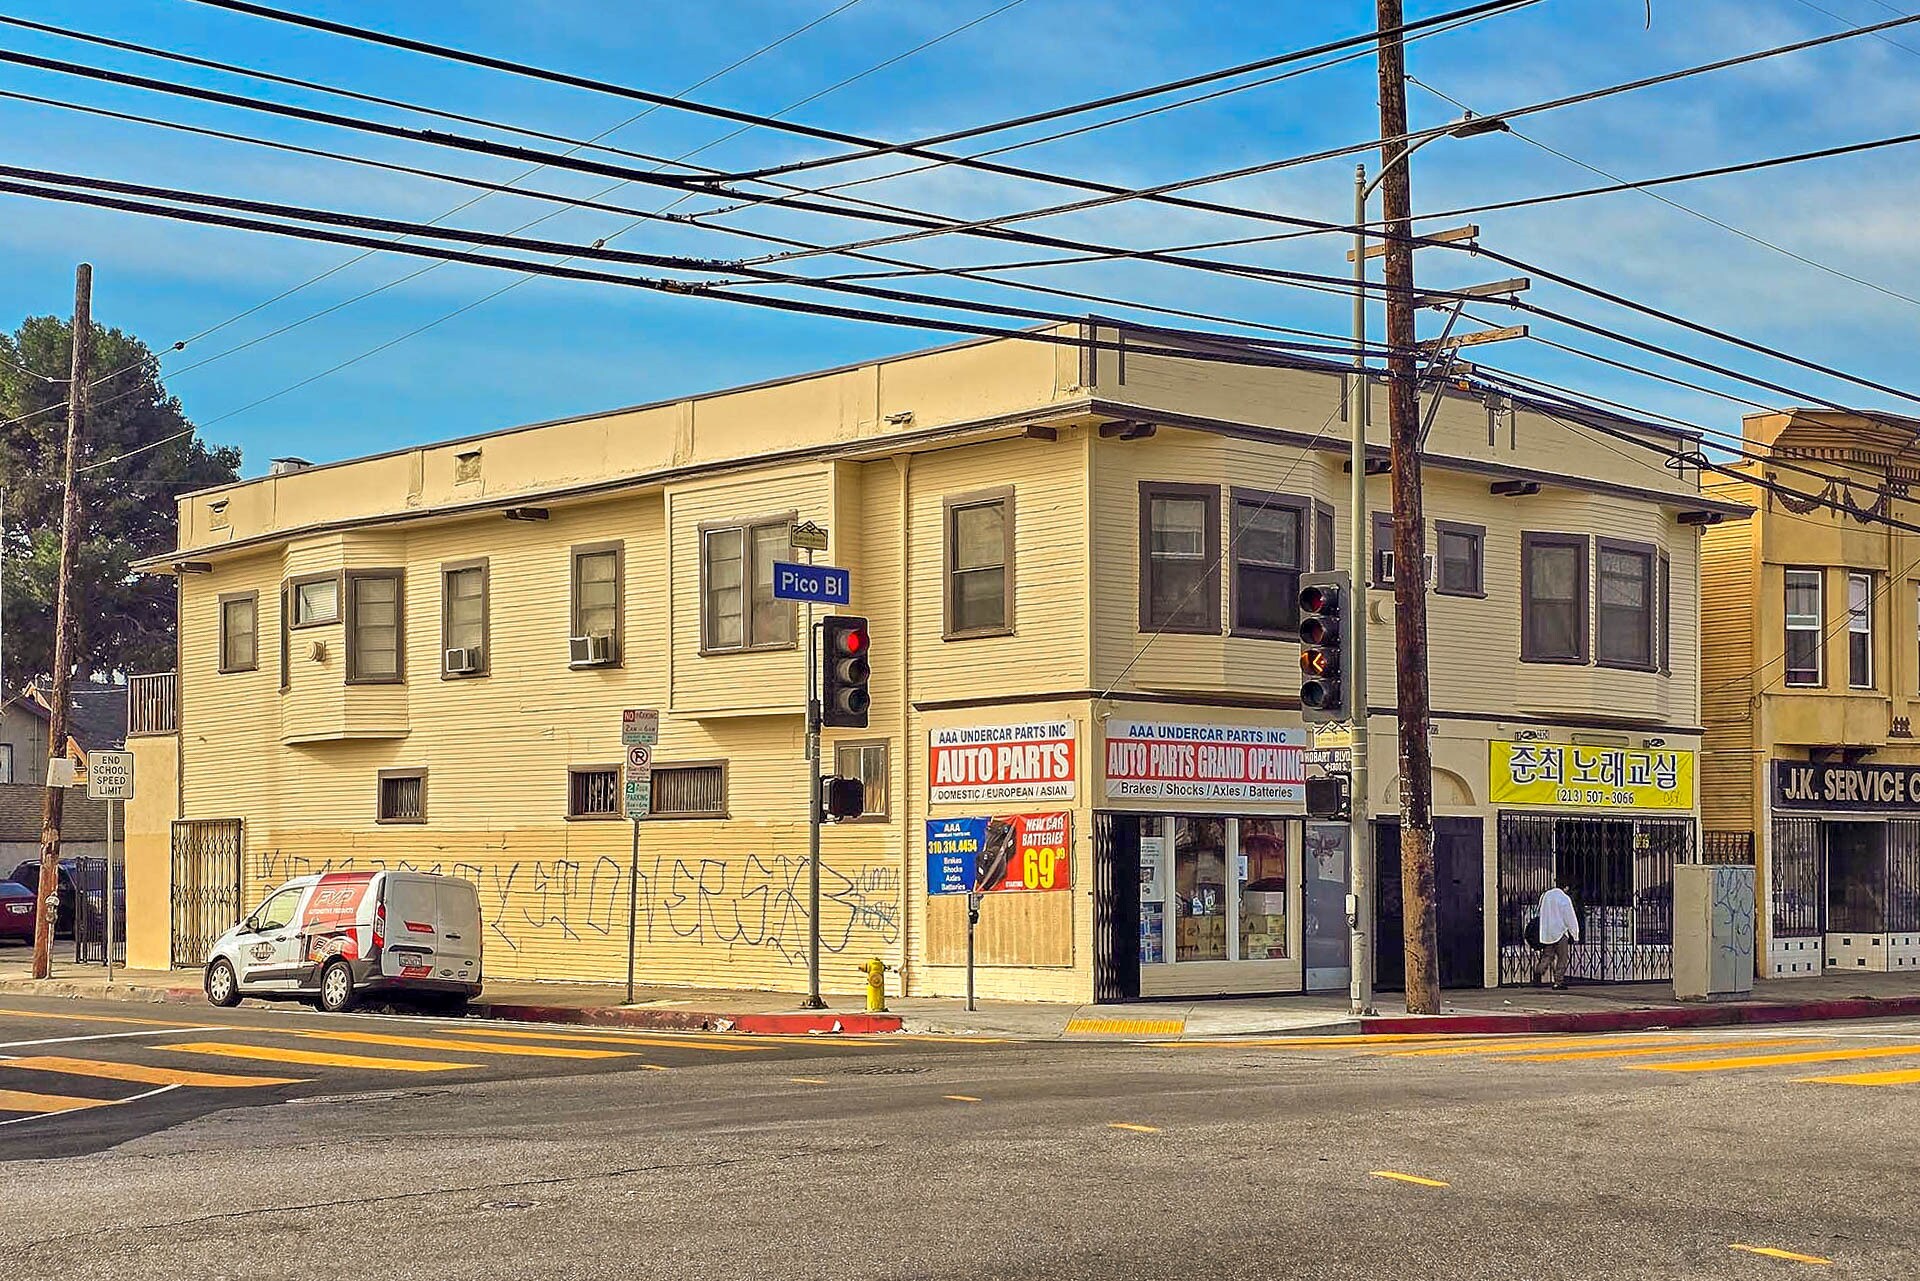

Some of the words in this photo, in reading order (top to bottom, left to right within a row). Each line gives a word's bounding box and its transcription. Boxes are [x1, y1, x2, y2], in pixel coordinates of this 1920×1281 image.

[782, 571, 818, 594] Pico
[825, 577, 842, 596] Bl
[624, 711, 634, 720] NO
[939, 731, 958, 743] AAA
[961, 728, 1012, 742] UNDERCAR
[1015, 726, 1045, 739] PARTS
[1048, 724, 1066, 737] INC
[1129, 725, 1155, 738] AAA
[1158, 726, 1223, 740] UNDERCAR
[1226, 729, 1263, 742] PARTS
[1266, 730, 1286, 743] INC
[102, 756, 120, 765] END
[936, 747, 993, 783] AUTO
[997, 743, 1070, 781] PARTS
[1108, 742, 1147, 776] AUTO
[1150, 743, 1195, 778] PARTS
[1197, 745, 1245, 779] GRAND
[1249, 748, 1304, 781] OPENING
[1304, 751, 1331, 763] HOBART
[1334, 750, 1351, 762] BLVD
[93, 766, 128, 775] SCHOOL
[1510, 745, 1563, 784] 준최
[1572, 750, 1677, 789] 노래교실
[96, 776, 126, 785] SPEED
[627, 783, 634, 792] 2
[1785, 768, 1819, 800] J.K.
[1824, 769, 1905, 802] SERVICE
[99, 786, 122, 795] LIMIT
[938, 788, 980, 799] DOMESTIC
[987, 787, 1034, 798] EUROPEAN
[1041, 785, 1067, 796] ASIAN
[1121, 782, 1157, 795] Brakes
[1159, 783, 1163, 794] /
[1166, 783, 1204, 796] Shocks
[1206, 784, 1211, 796] /
[1213, 785, 1240, 797] Axles
[1242, 786, 1247, 797] /
[1250, 786, 1293, 798] Batteries
[1556, 789, 1582, 802] (213)
[943, 823, 961, 832] AAA
[1026, 818, 1046, 832] NEW
[1046, 816, 1064, 831] CAR
[928, 839, 978, 854] 310.314.4454
[1022, 831, 1064, 847] BATTERIES
[943, 866, 963, 874] Shocks
[1024, 847, 1055, 889] 69
